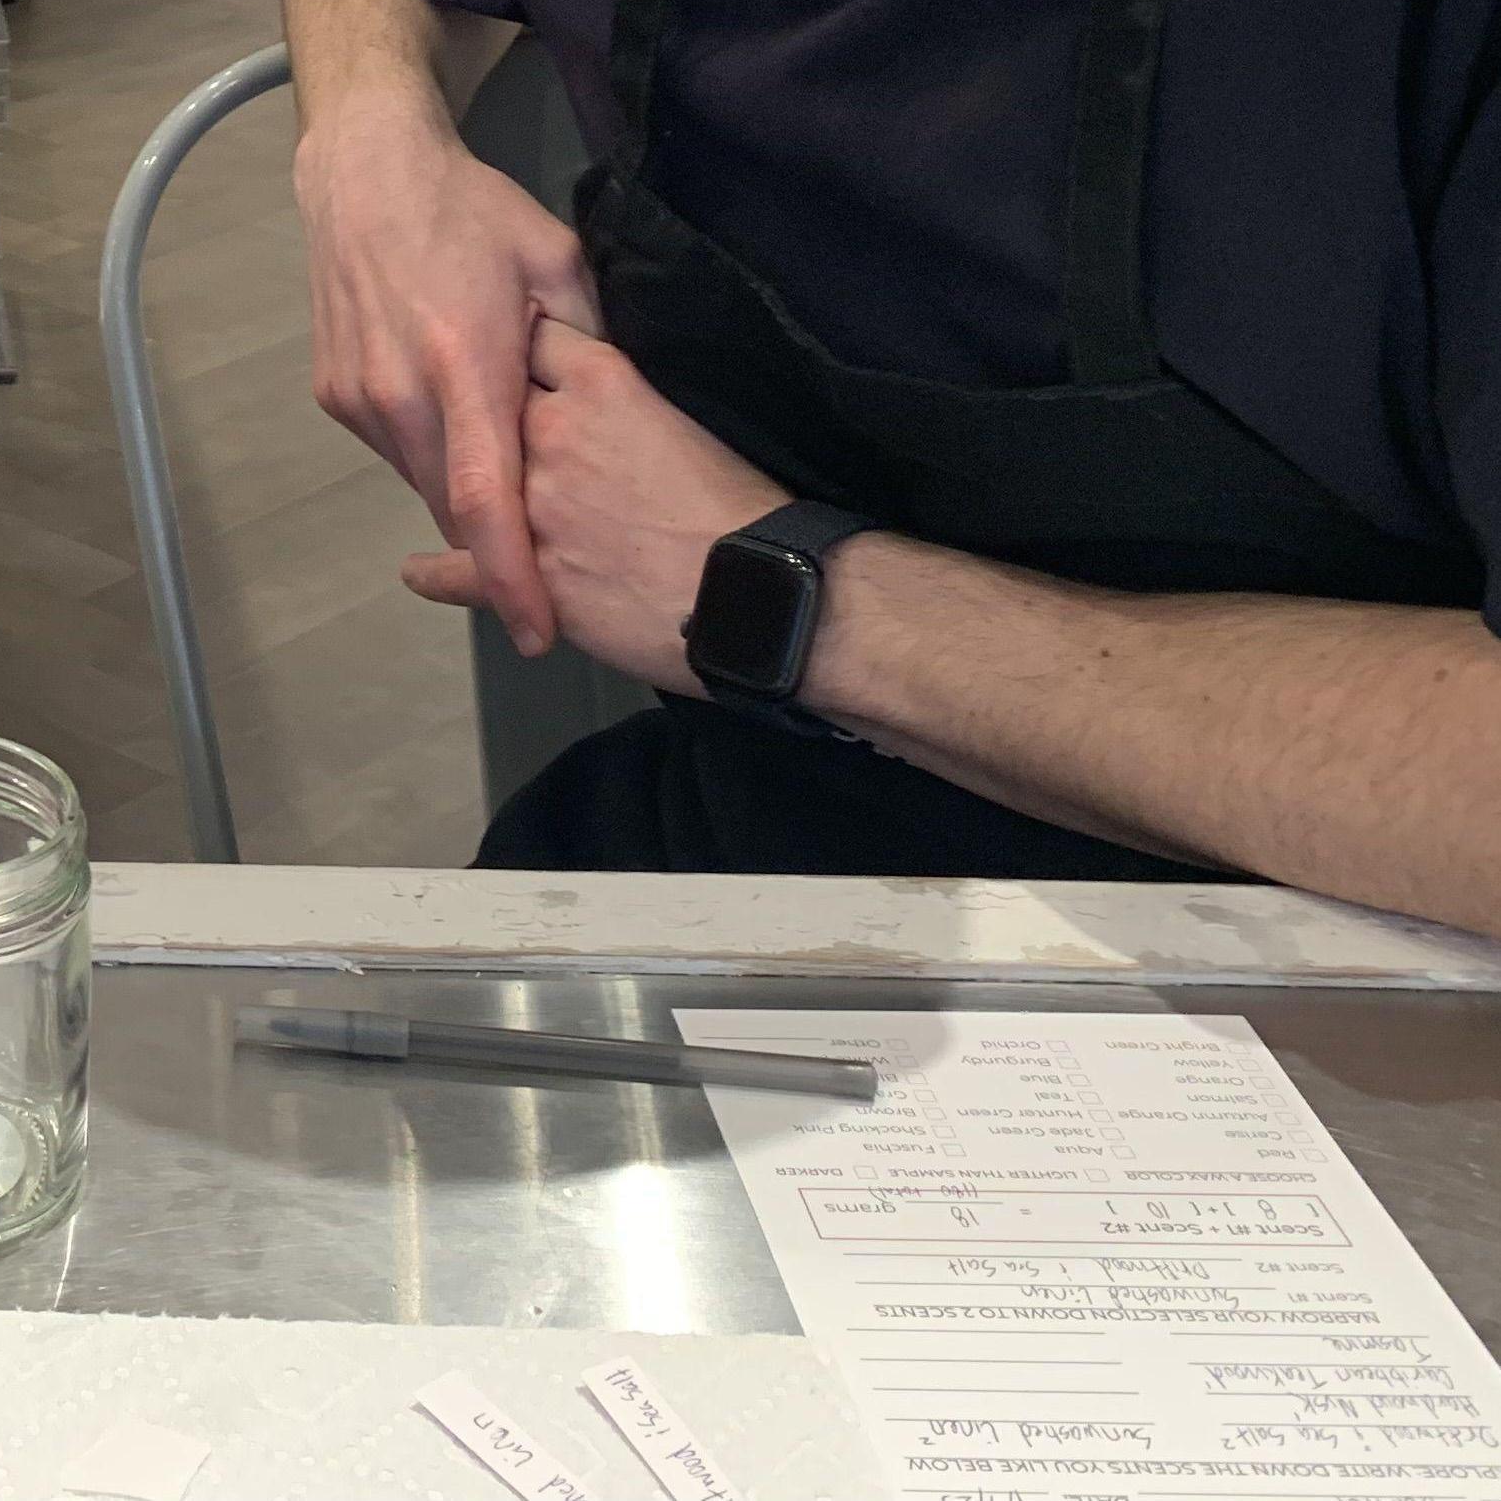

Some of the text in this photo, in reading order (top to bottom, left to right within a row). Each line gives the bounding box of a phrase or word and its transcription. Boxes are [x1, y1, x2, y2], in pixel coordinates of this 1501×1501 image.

[830, 1039, 881, 1049] Other
[980, 1040, 1040, 1051] Orchid
[1105, 1040, 1220, 1052] Bright Green
[960, 1055, 1050, 1067] Burgundy
[1173, 1058, 1233, 1069] Yellow
[1020, 1074, 1061, 1085] Blue
[1176, 1074, 1245, 1087] Orange
[1035, 1091, 1073, 1102] Teal
[1187, 1094, 1259, 1105] Salmon
[958, 1108, 1083, 1120] Hunter Green
[1118, 1109, 1269, 1123] Autumn Orange
[792, 1123, 926, 1136] Shocking Pink
[988, 1126, 1091, 1138] Jade Green
[863, 1143, 935, 1154] Fuschia
[1054, 1144, 1104, 1156] Aqua
[1257, 1148, 1295, 1159] Red
[775, 1166, 842, 1177] DARKER
[888, 1167, 1078, 1181] LIGHTER THAN SAMPLE
[1126, 1171, 1184, 1182] COLOR
[1247, 1173, 1318, 1184] CHOOSE
[824, 1201, 897, 1216] grams
[950, 1206, 979, 1228] 18
[1099, 1222, 1131, 1235] #2
[1135, 1222, 1202, 1236] Scent
[1226, 1223, 1251, 1236] #1
[1256, 1223, 1325, 1237] Scent
[946, 1258, 997, 1279] Salt
[1255, 1262, 1283, 1274] #2
[1288, 1262, 1345, 1275] Scent
[1106, 1288, 1240, 1310] Sunwashed
[1286, 1291, 1311, 1304] #1
[1317, 1292, 1374, 1305] Scent
[875, 1305, 1381, 1325] NARROW YOUR SELECTION DOWN TO 2 SCENTS
[1017, 1422, 1151, 1450] Sunwashed
[909, 1458, 1501, 1480] PLORE: WRITE DOWN THE SCENTS YOU LIKE BELOW
